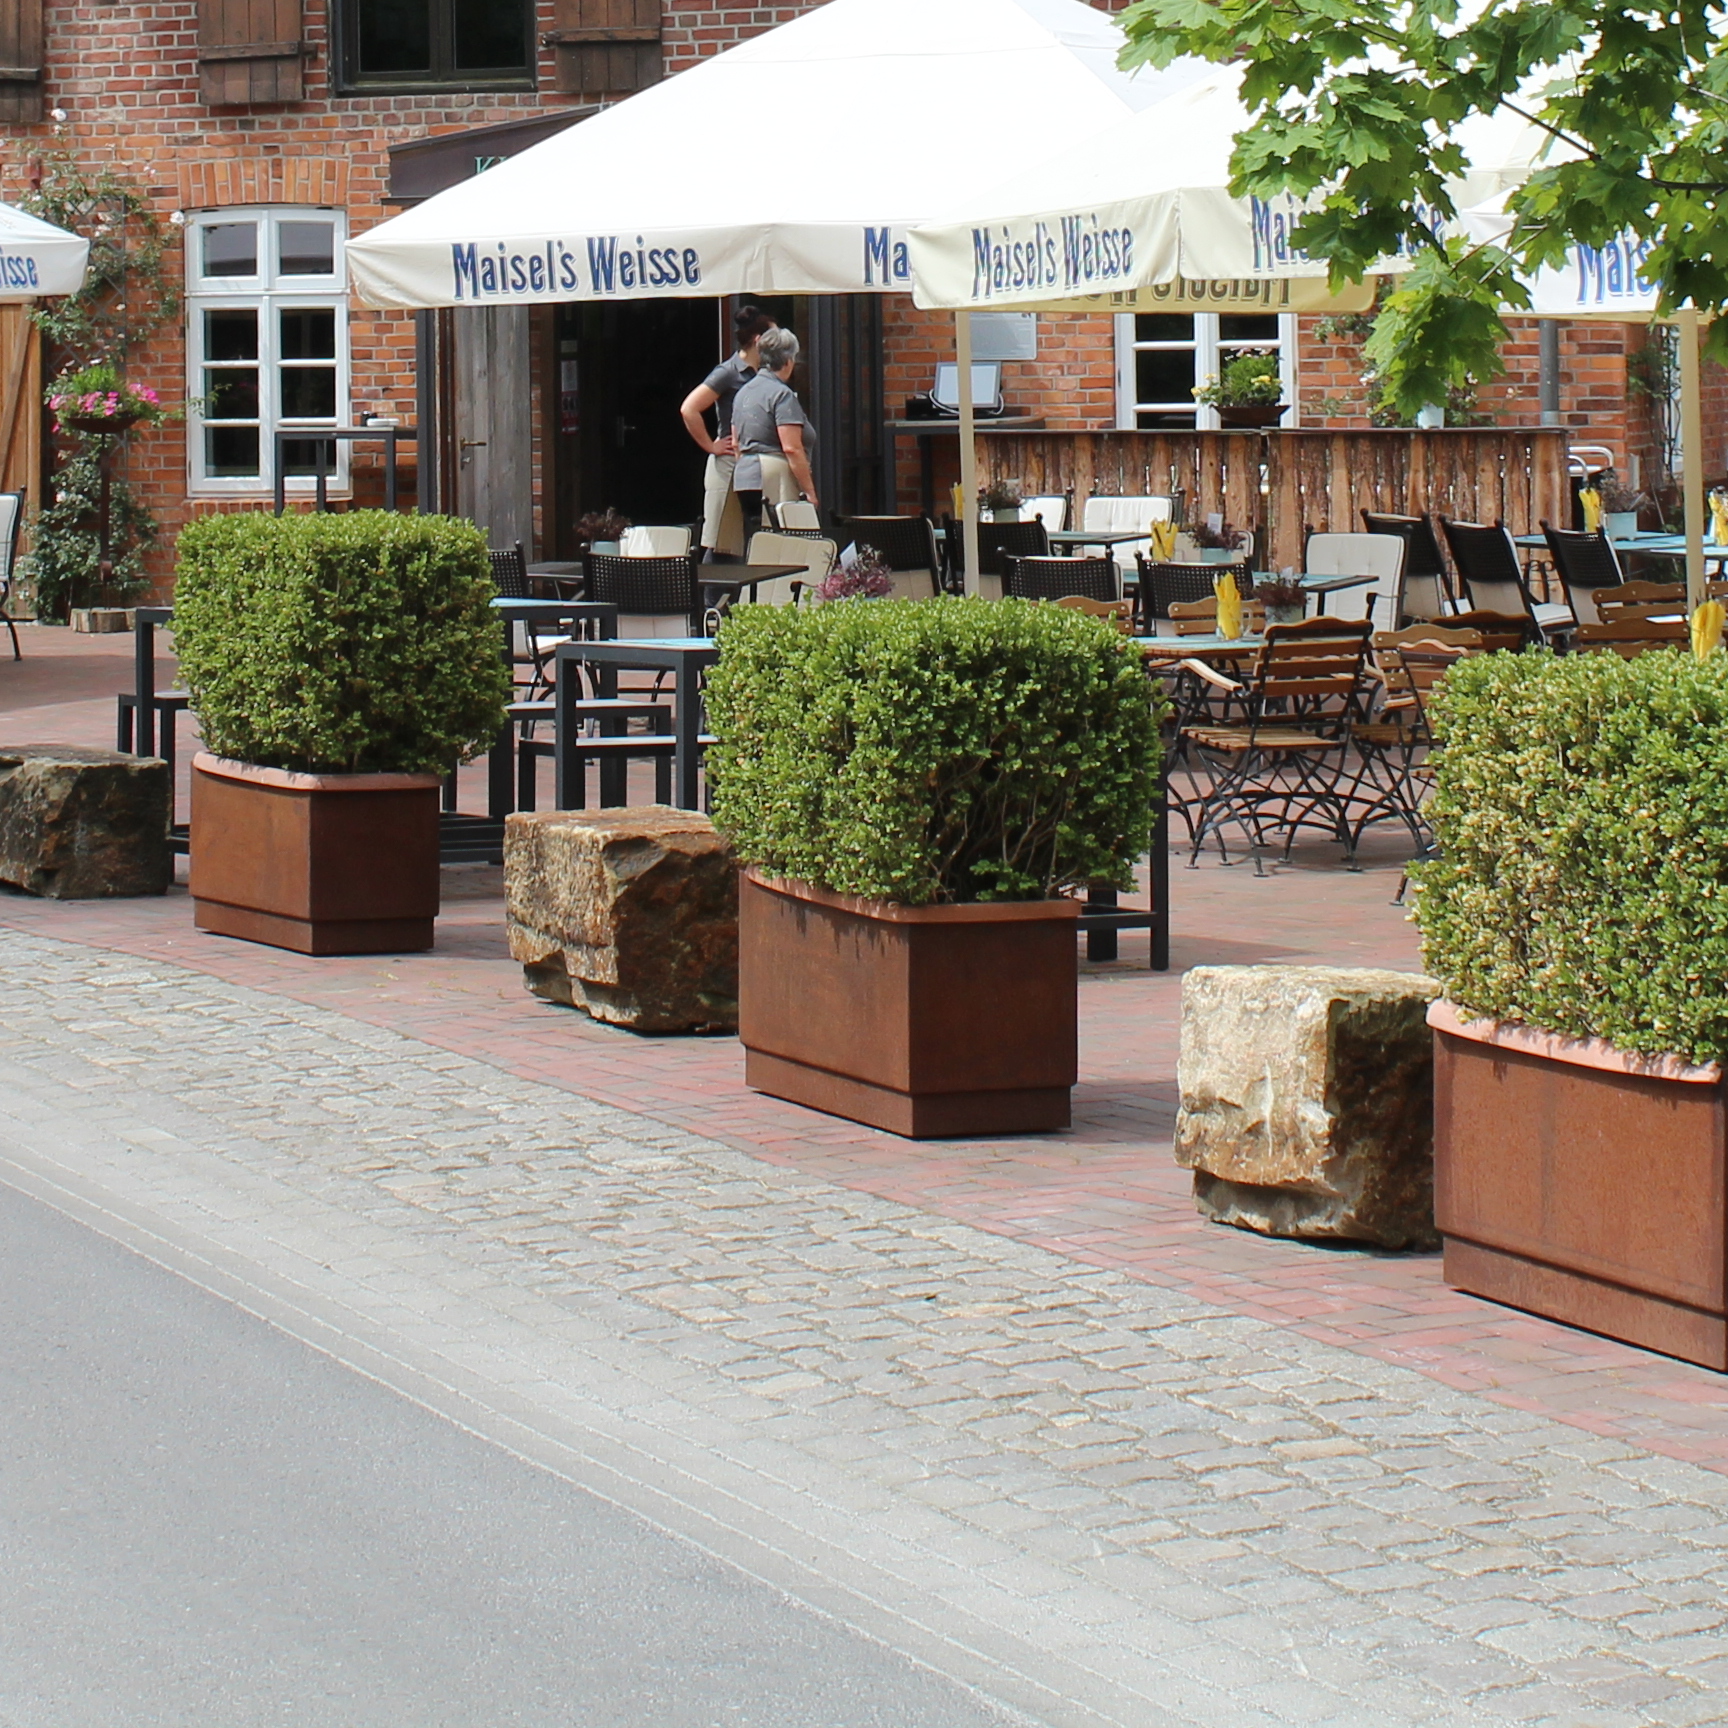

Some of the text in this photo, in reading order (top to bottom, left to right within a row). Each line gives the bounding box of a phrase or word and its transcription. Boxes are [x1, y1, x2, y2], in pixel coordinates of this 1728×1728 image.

[450, 234, 702, 300] Maisel's Weisse
[970, 212, 1136, 301] Maisel's Weisse
